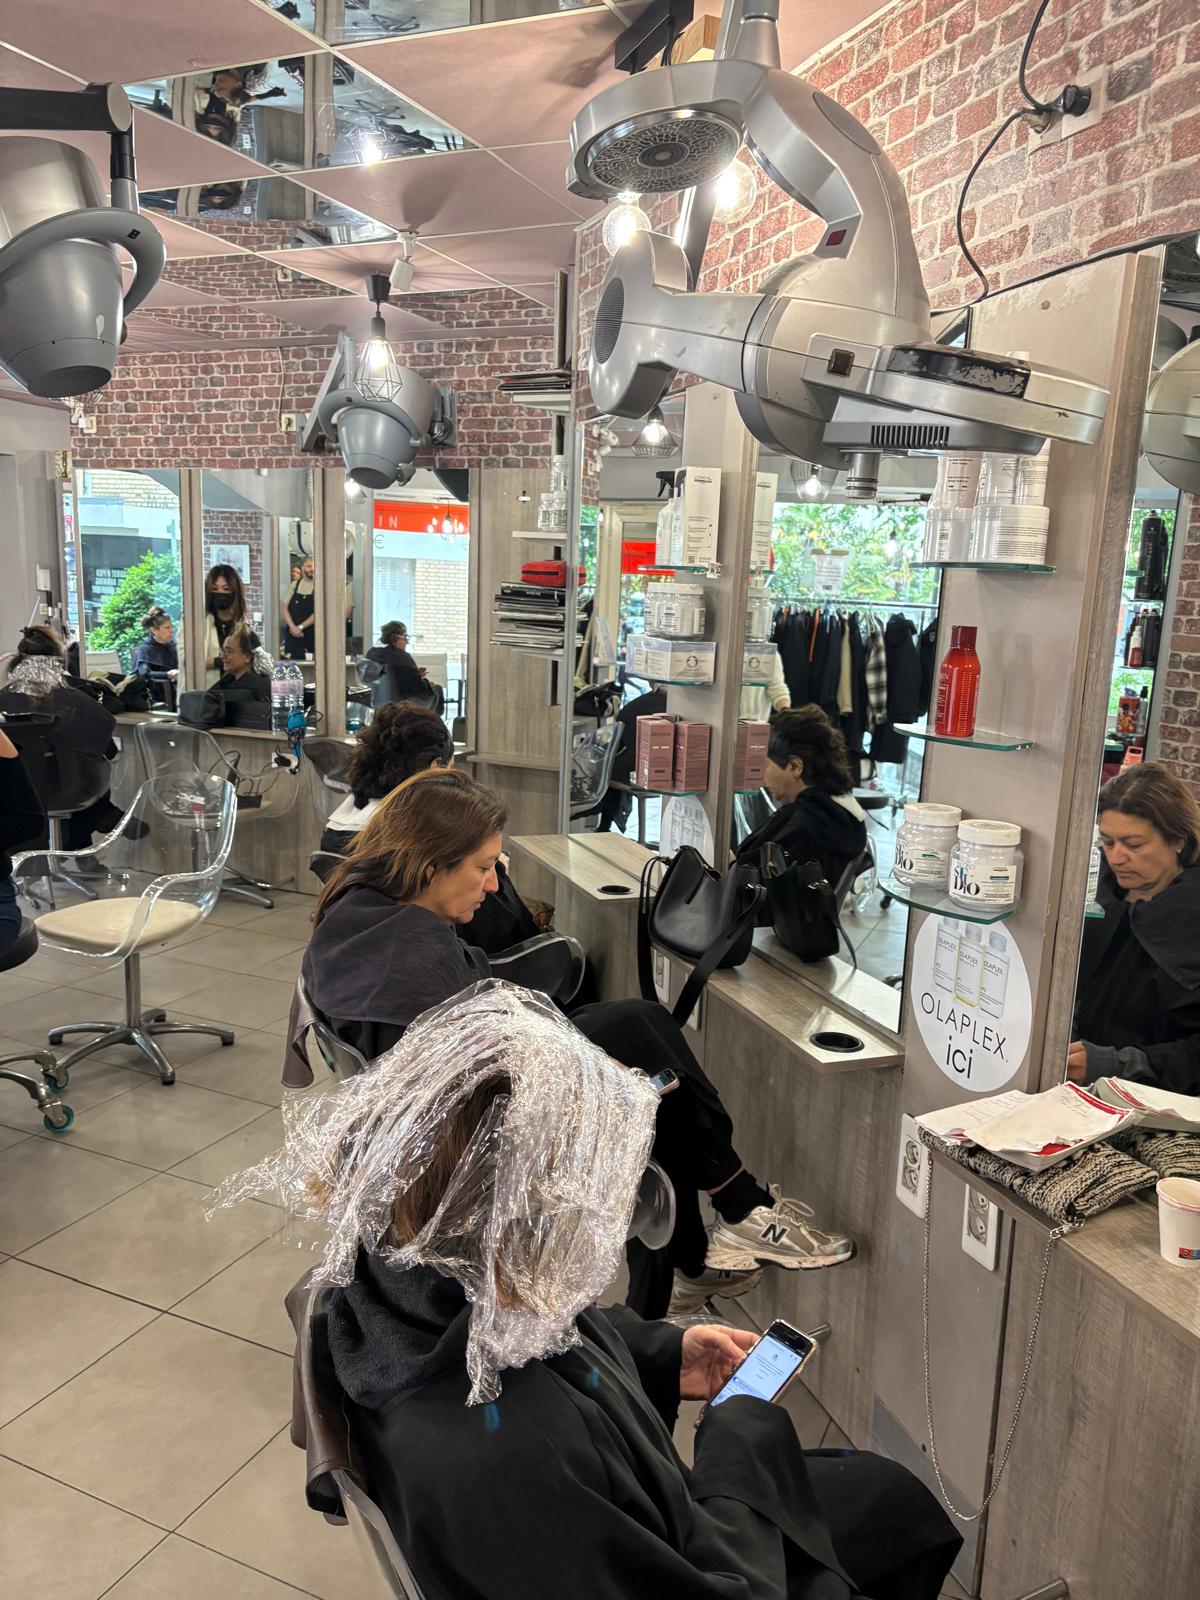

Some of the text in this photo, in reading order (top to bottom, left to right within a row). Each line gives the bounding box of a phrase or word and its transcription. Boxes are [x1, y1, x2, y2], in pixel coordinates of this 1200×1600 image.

[984, 961, 1003, 974] OLAPLEX
[921, 992, 1007, 1061] OLAPLEX
[946, 1035, 973, 1078] ici
[761, 1223, 787, 1244] N
